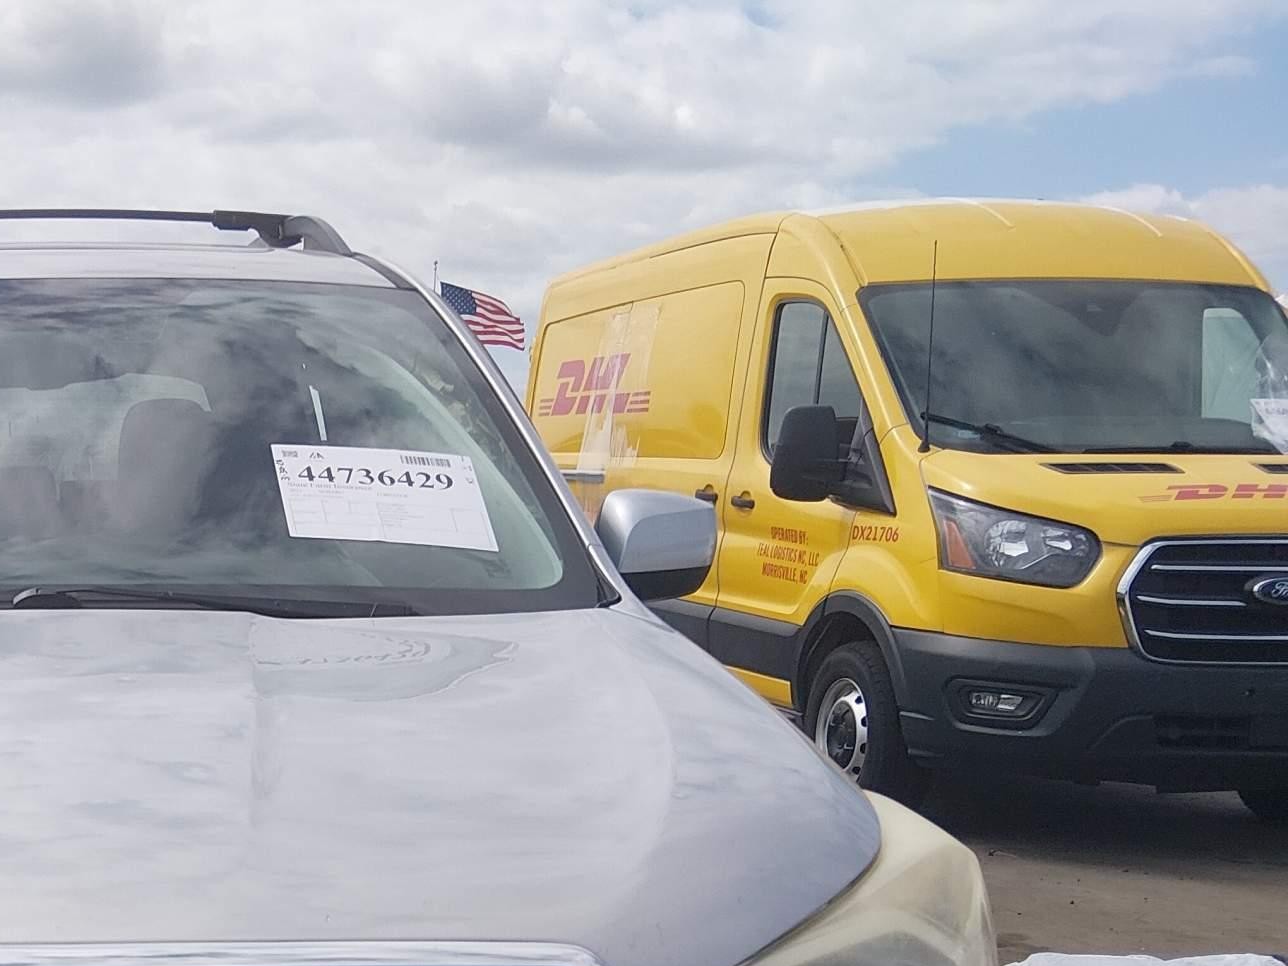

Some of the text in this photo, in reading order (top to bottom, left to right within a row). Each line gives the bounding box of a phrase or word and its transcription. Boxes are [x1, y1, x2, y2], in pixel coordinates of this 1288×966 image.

[550, 353, 631, 416] DHL
[297, 465, 454, 490] 44736429
[770, 526, 798, 543] OPERATED
[851, 525, 899, 542] DX21706
[770, 545, 798, 563] LOGISTICS
[808, 552, 820, 567] LLC
[799, 569, 808, 585] NC
